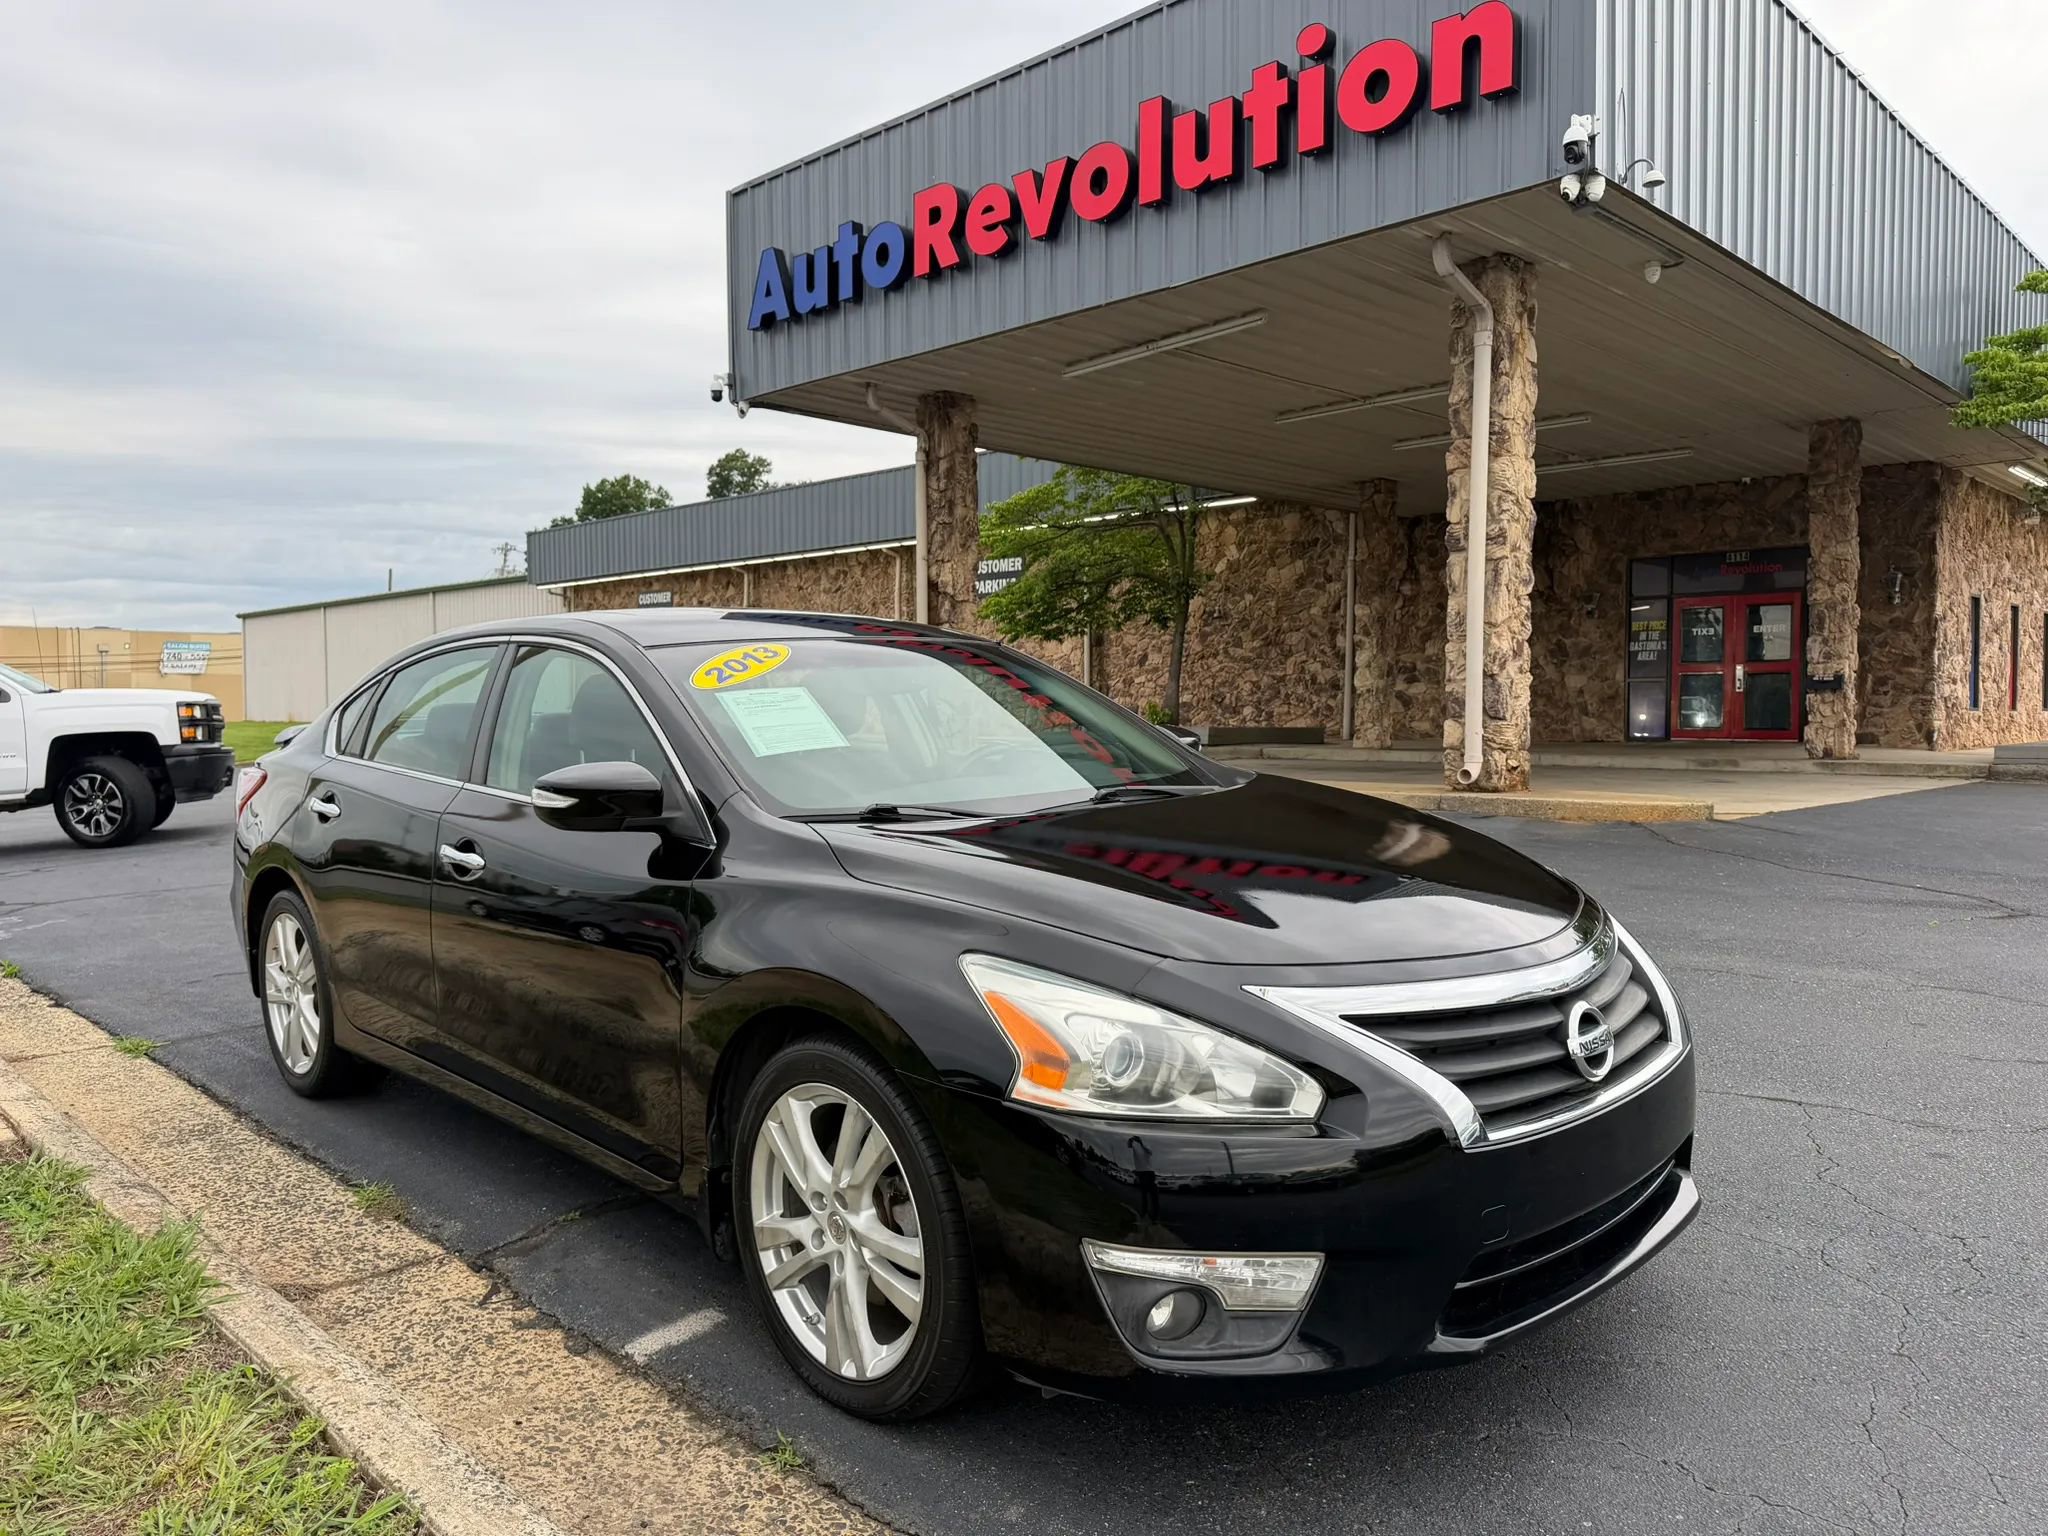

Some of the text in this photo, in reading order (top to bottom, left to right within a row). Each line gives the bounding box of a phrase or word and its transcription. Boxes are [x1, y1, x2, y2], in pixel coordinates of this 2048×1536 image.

[977, 556, 1022, 575] STOMER
[974, 578, 1016, 594] ARKIN
[1753, 624, 1786, 633] ENTER
[704, 646, 782, 684] 2013
